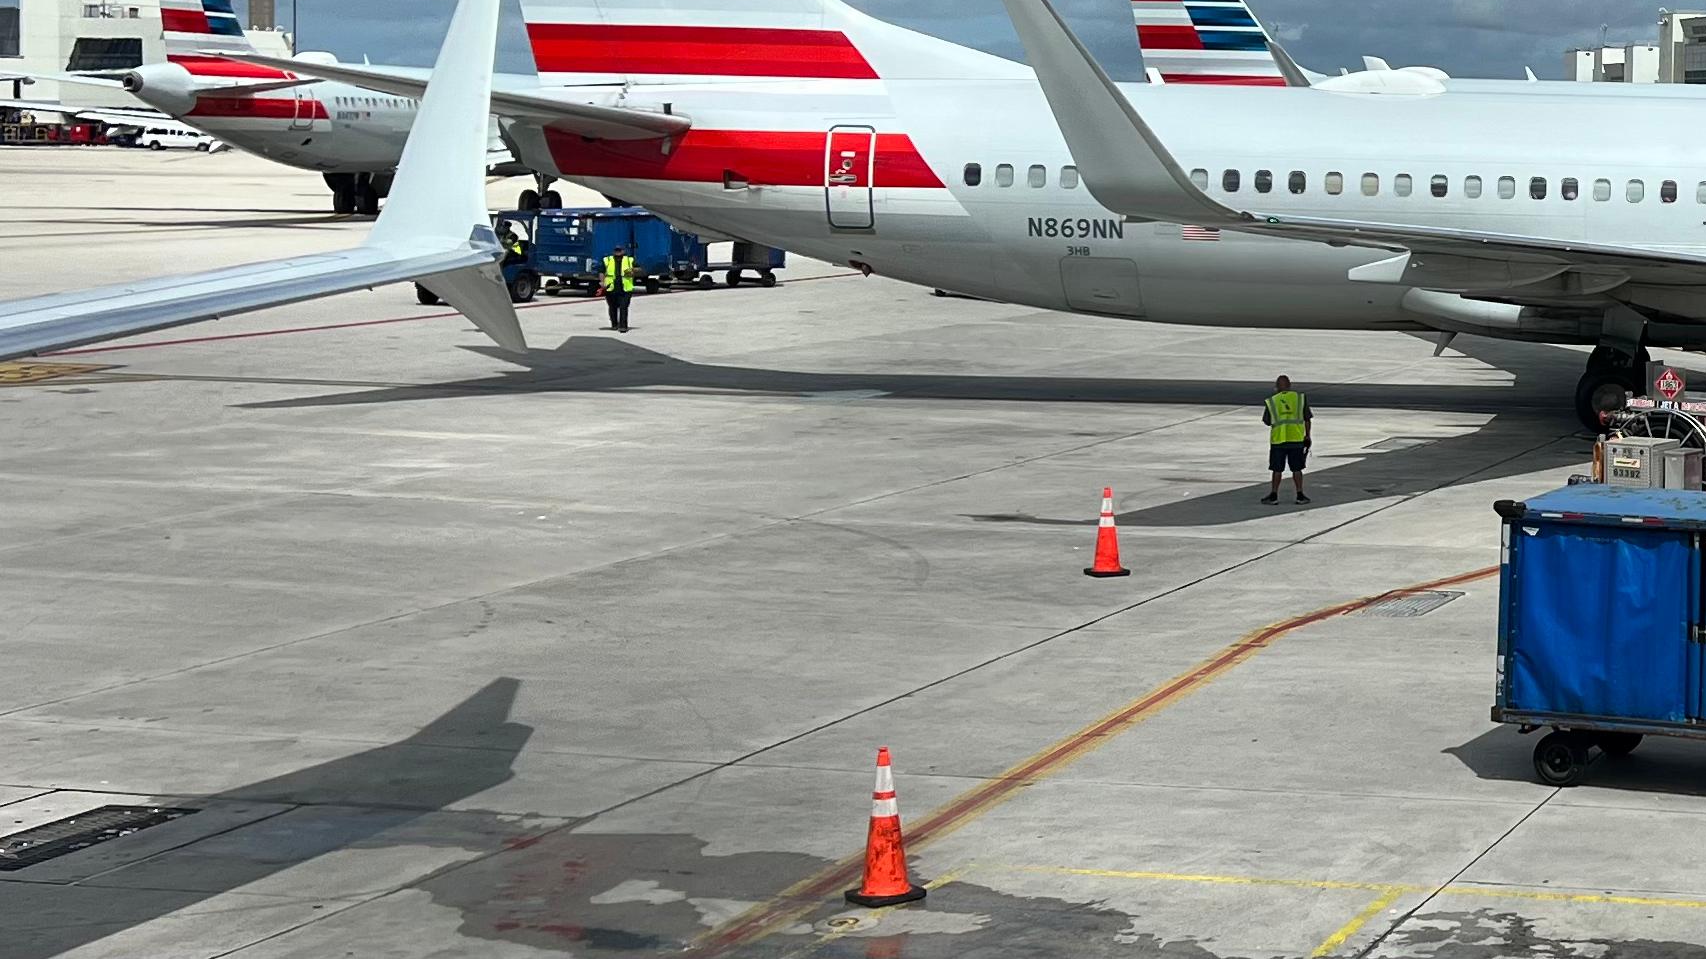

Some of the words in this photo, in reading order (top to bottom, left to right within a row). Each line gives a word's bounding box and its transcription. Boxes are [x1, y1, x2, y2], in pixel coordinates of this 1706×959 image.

[1028, 217, 1123, 239] N869NN
[1066, 245, 1091, 257] 3HB
[1660, 400, 1673, 410] JET
[1673, 401, 1680, 410] A
